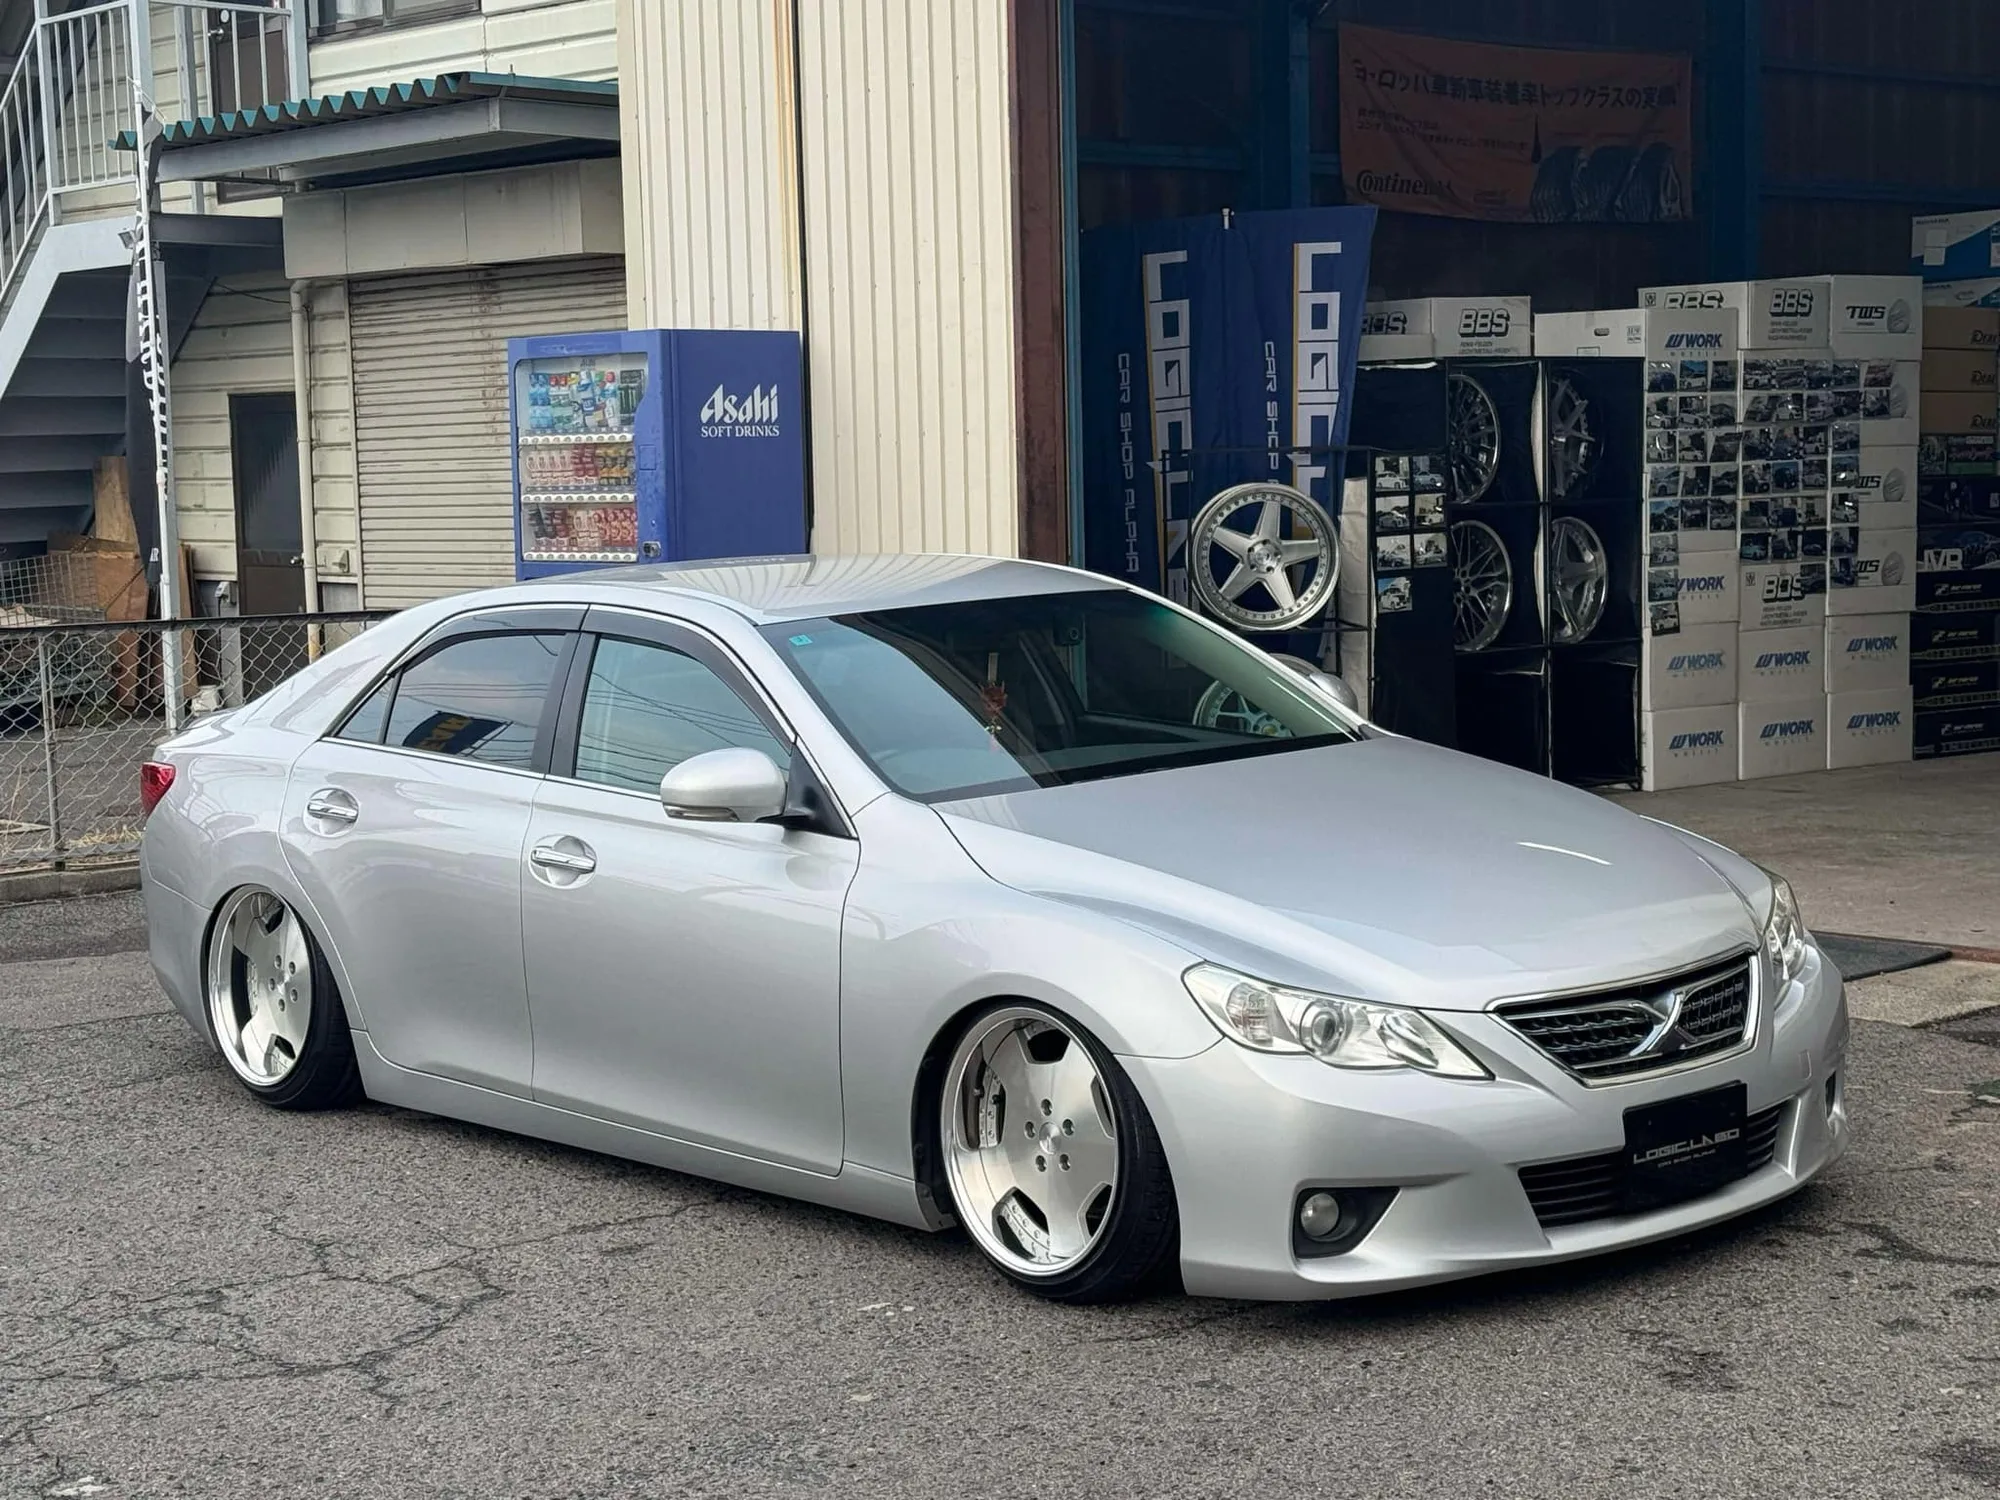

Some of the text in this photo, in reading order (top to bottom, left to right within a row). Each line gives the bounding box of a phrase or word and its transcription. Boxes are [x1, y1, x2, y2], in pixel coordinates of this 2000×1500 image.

[1769, 288, 1814, 317] BBS
[1846, 305, 1887, 319] TWS
[1458, 308, 1511, 337] BBS
[1685, 333, 1722, 348] WORK
[1265, 340, 1278, 393] CAR
[700, 383, 778, 424] Asahi
[701, 425, 780, 438] SOFT DRINKS
[1117, 352, 1140, 573] CAR SHOP ALPHA
[1856, 476, 1881, 488] WS
[1856, 559, 1880, 573] WS
[1686, 575, 1725, 592] WORK
[1863, 635, 1898, 651] WORK
[1687, 652, 1726, 668] WORK
[1773, 650, 1811, 666] WORK
[1864, 710, 1901, 728] WORK
[1776, 719, 1814, 737] WORK
[1686, 730, 1725, 746] WORK
